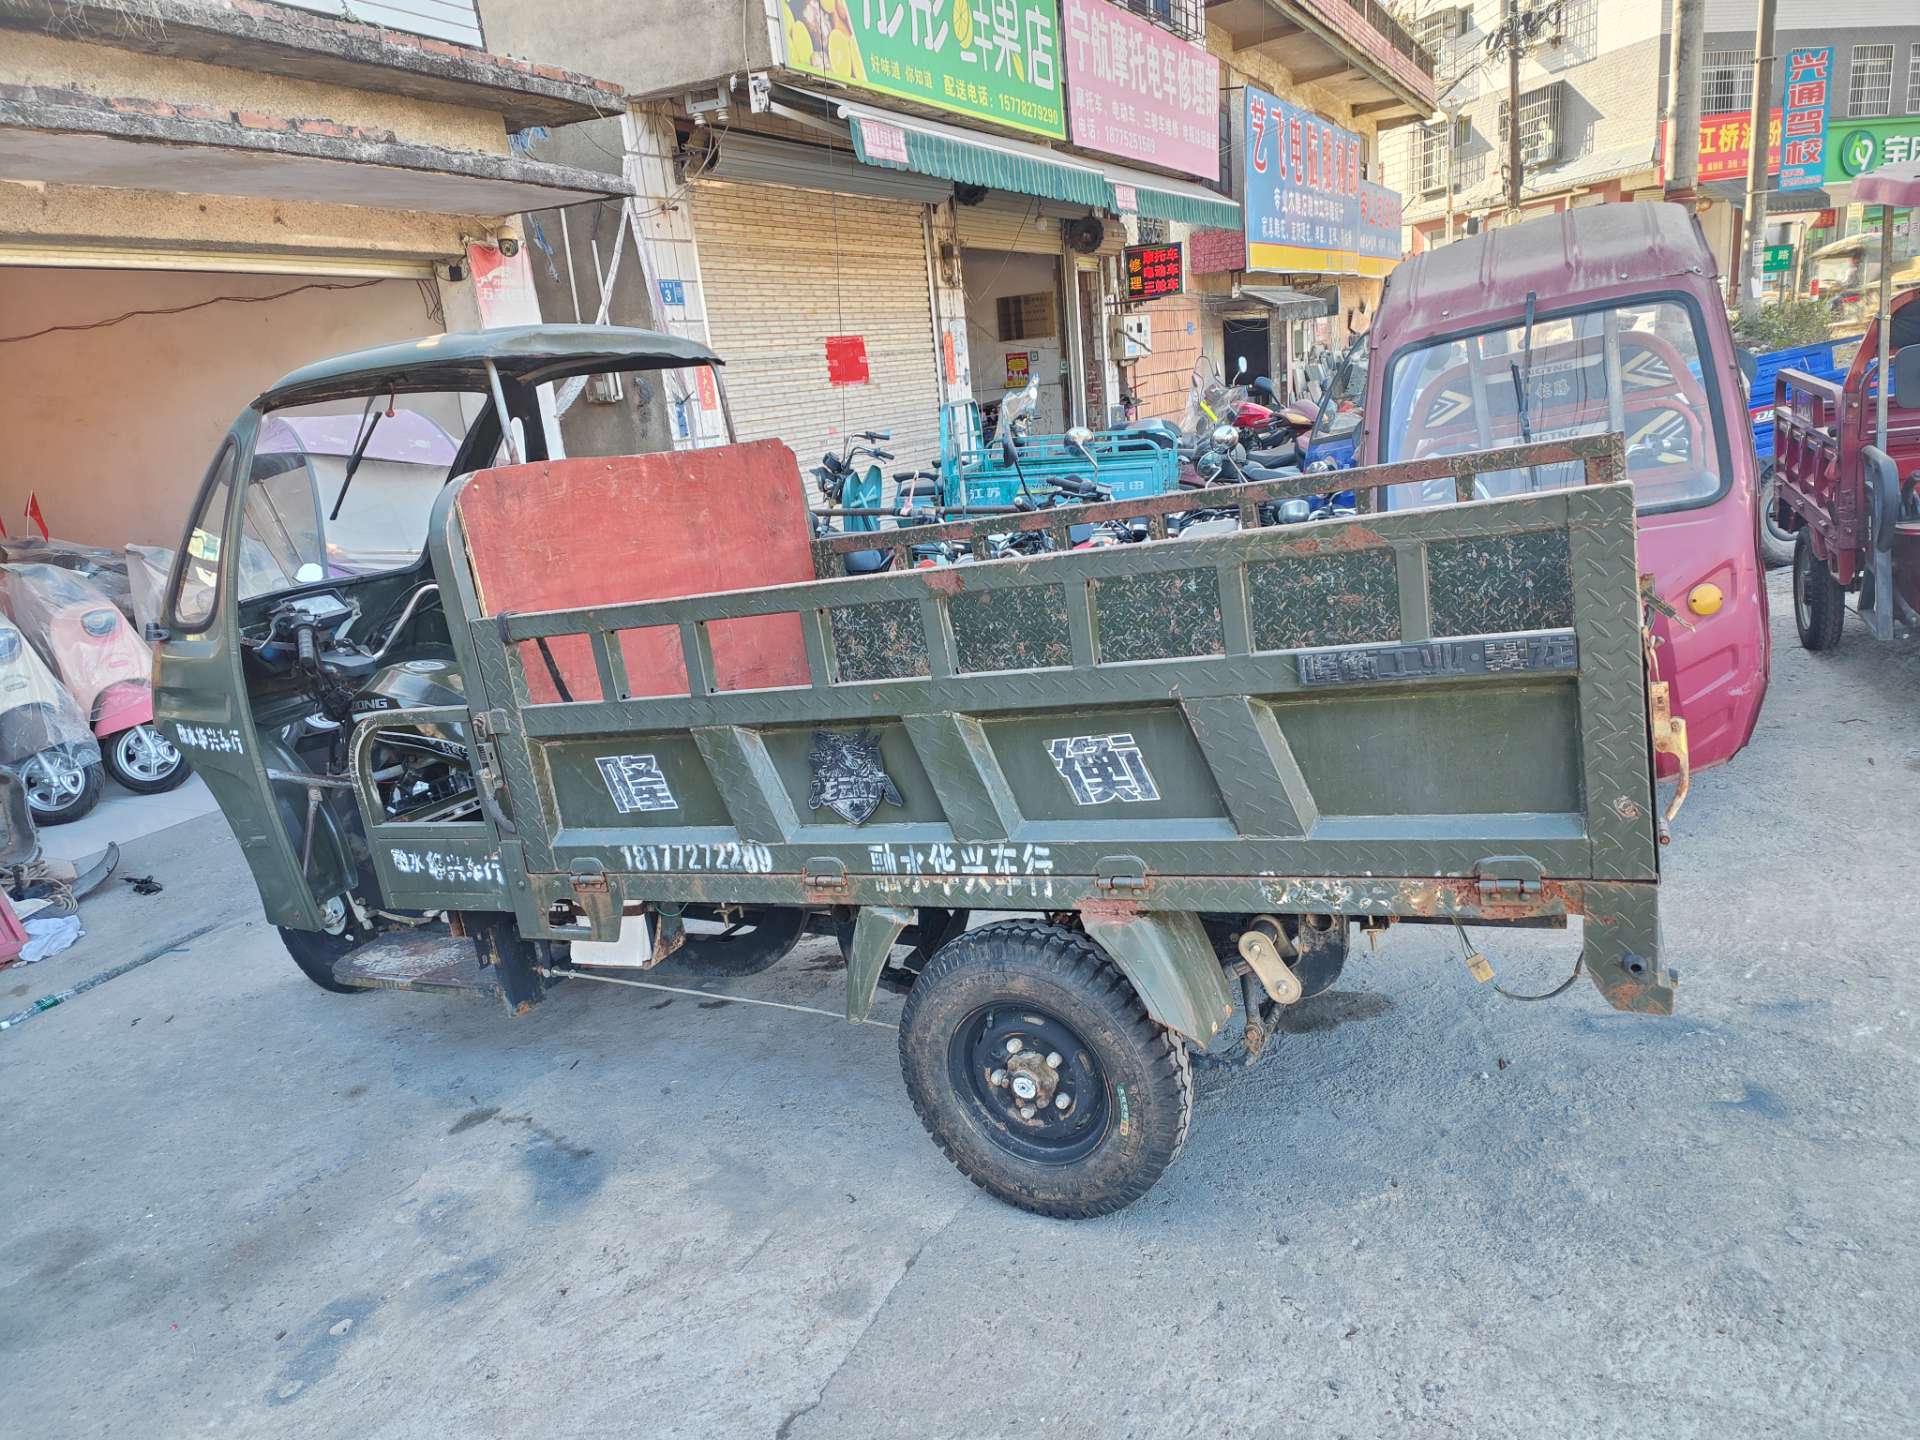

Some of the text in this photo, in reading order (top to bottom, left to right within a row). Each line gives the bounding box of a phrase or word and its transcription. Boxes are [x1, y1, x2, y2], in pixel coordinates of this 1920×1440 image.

[1784, 51, 1828, 166] 兴通驾校
[1143, 247, 1178, 265] 摩托车
[1129, 258, 1143, 290] 修理
[1143, 263, 1178, 279] 电动车
[1144, 278, 1179, 295] 三轮车
[665, 289, 672, 302] 3
